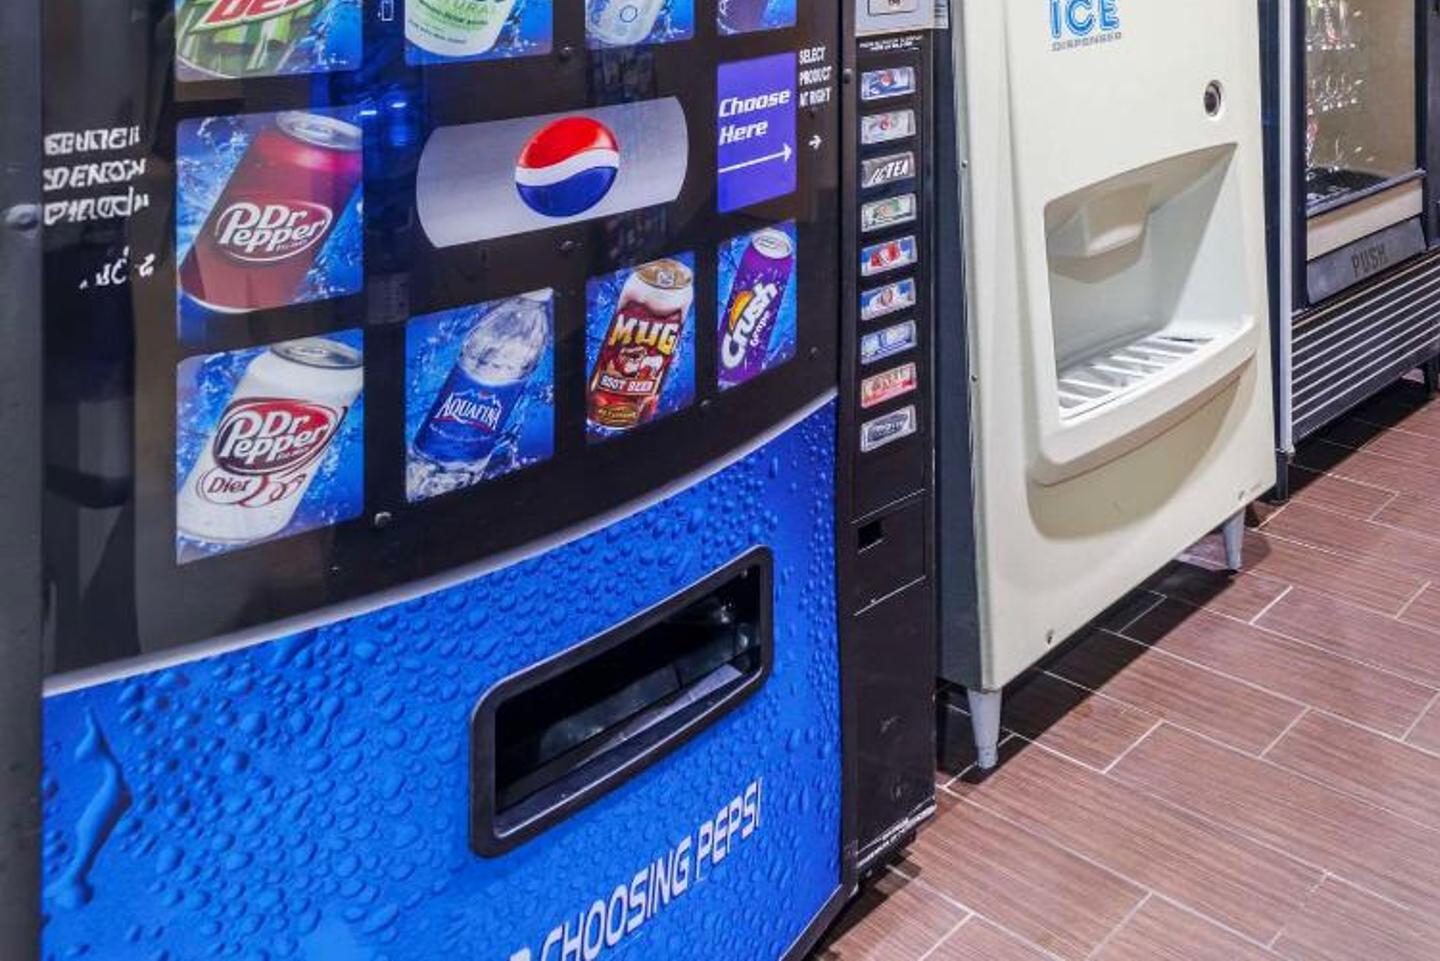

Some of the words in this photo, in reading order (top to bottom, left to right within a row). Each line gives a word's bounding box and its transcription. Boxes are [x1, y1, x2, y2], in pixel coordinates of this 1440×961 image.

[799, 46, 826, 65] SELECT
[718, 89, 791, 118] Choose
[718, 120, 769, 147] Here
[218, 202, 326, 254] Pepper
[255, 205, 308, 229] Dr
[608, 313, 680, 356] MUG
[721, 280, 779, 369] Crush
[218, 410, 330, 465] Pepper
[262, 410, 311, 437] Dr
[207, 477, 252, 494] Diet
[541, 836, 692, 961] CHOOSING
[696, 776, 763, 882] PEPSI
